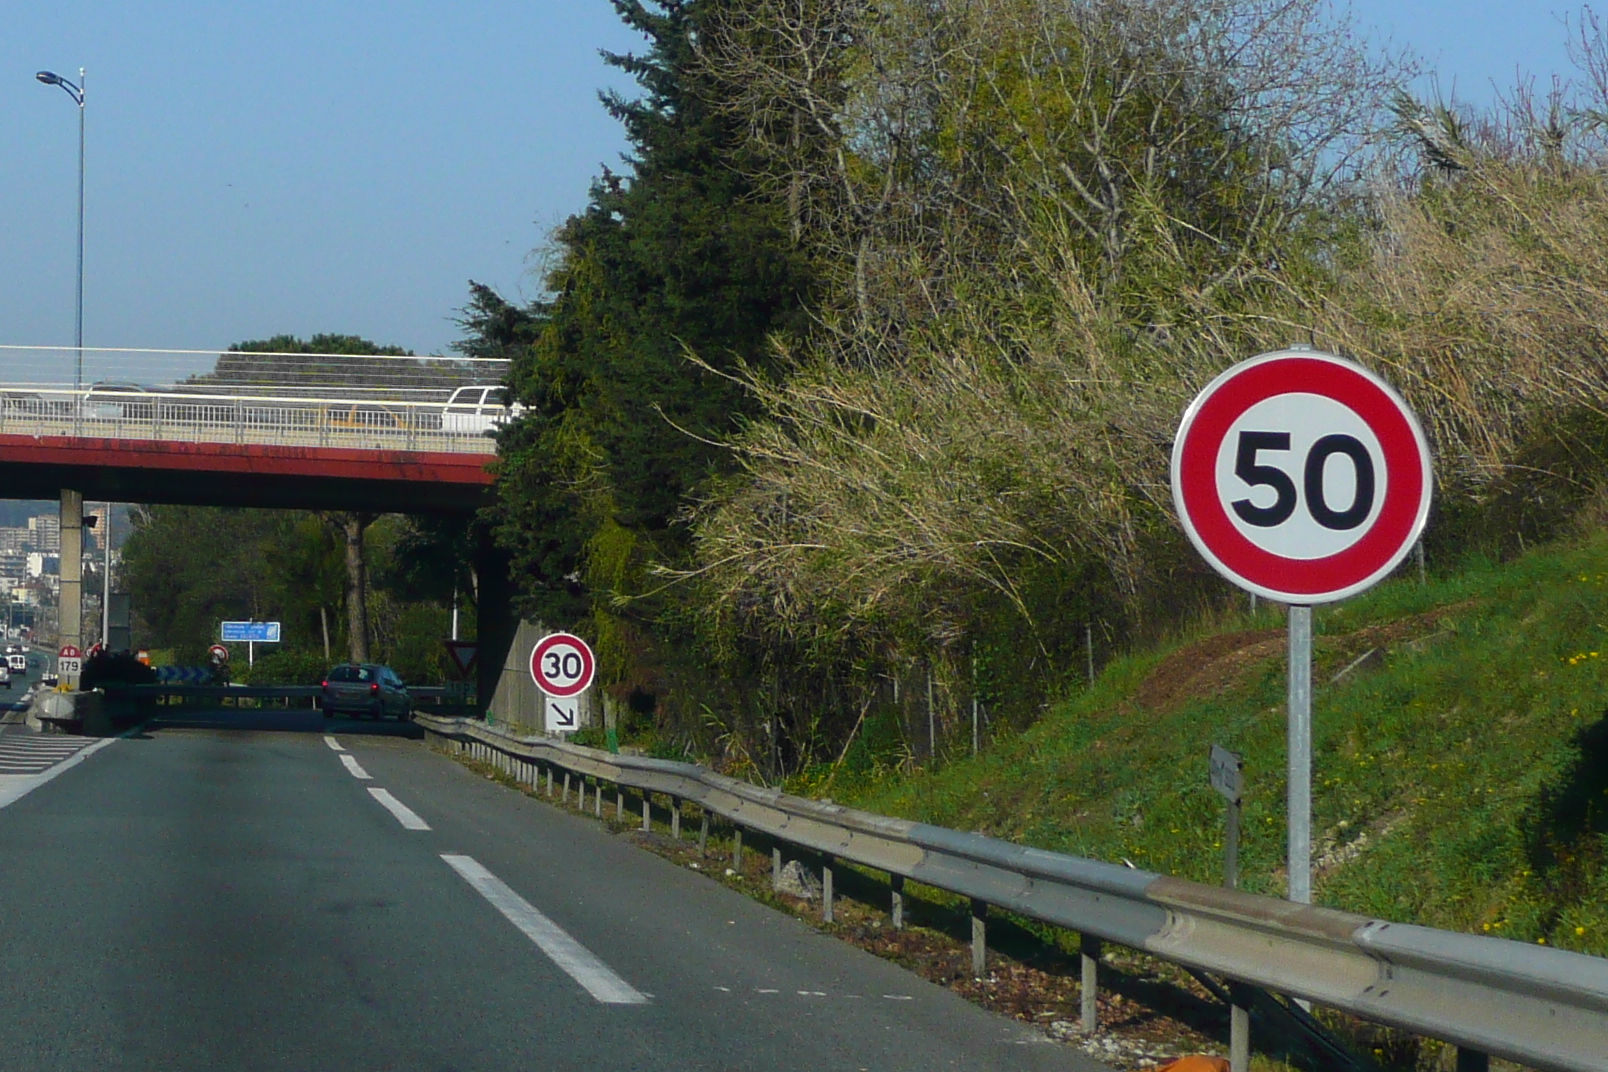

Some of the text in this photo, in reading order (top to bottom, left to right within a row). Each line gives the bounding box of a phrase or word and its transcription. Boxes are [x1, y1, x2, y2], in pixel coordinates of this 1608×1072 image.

[1231, 431, 1375, 530] 50
[60, 661, 79, 672] 179
[544, 652, 582, 679] 30
